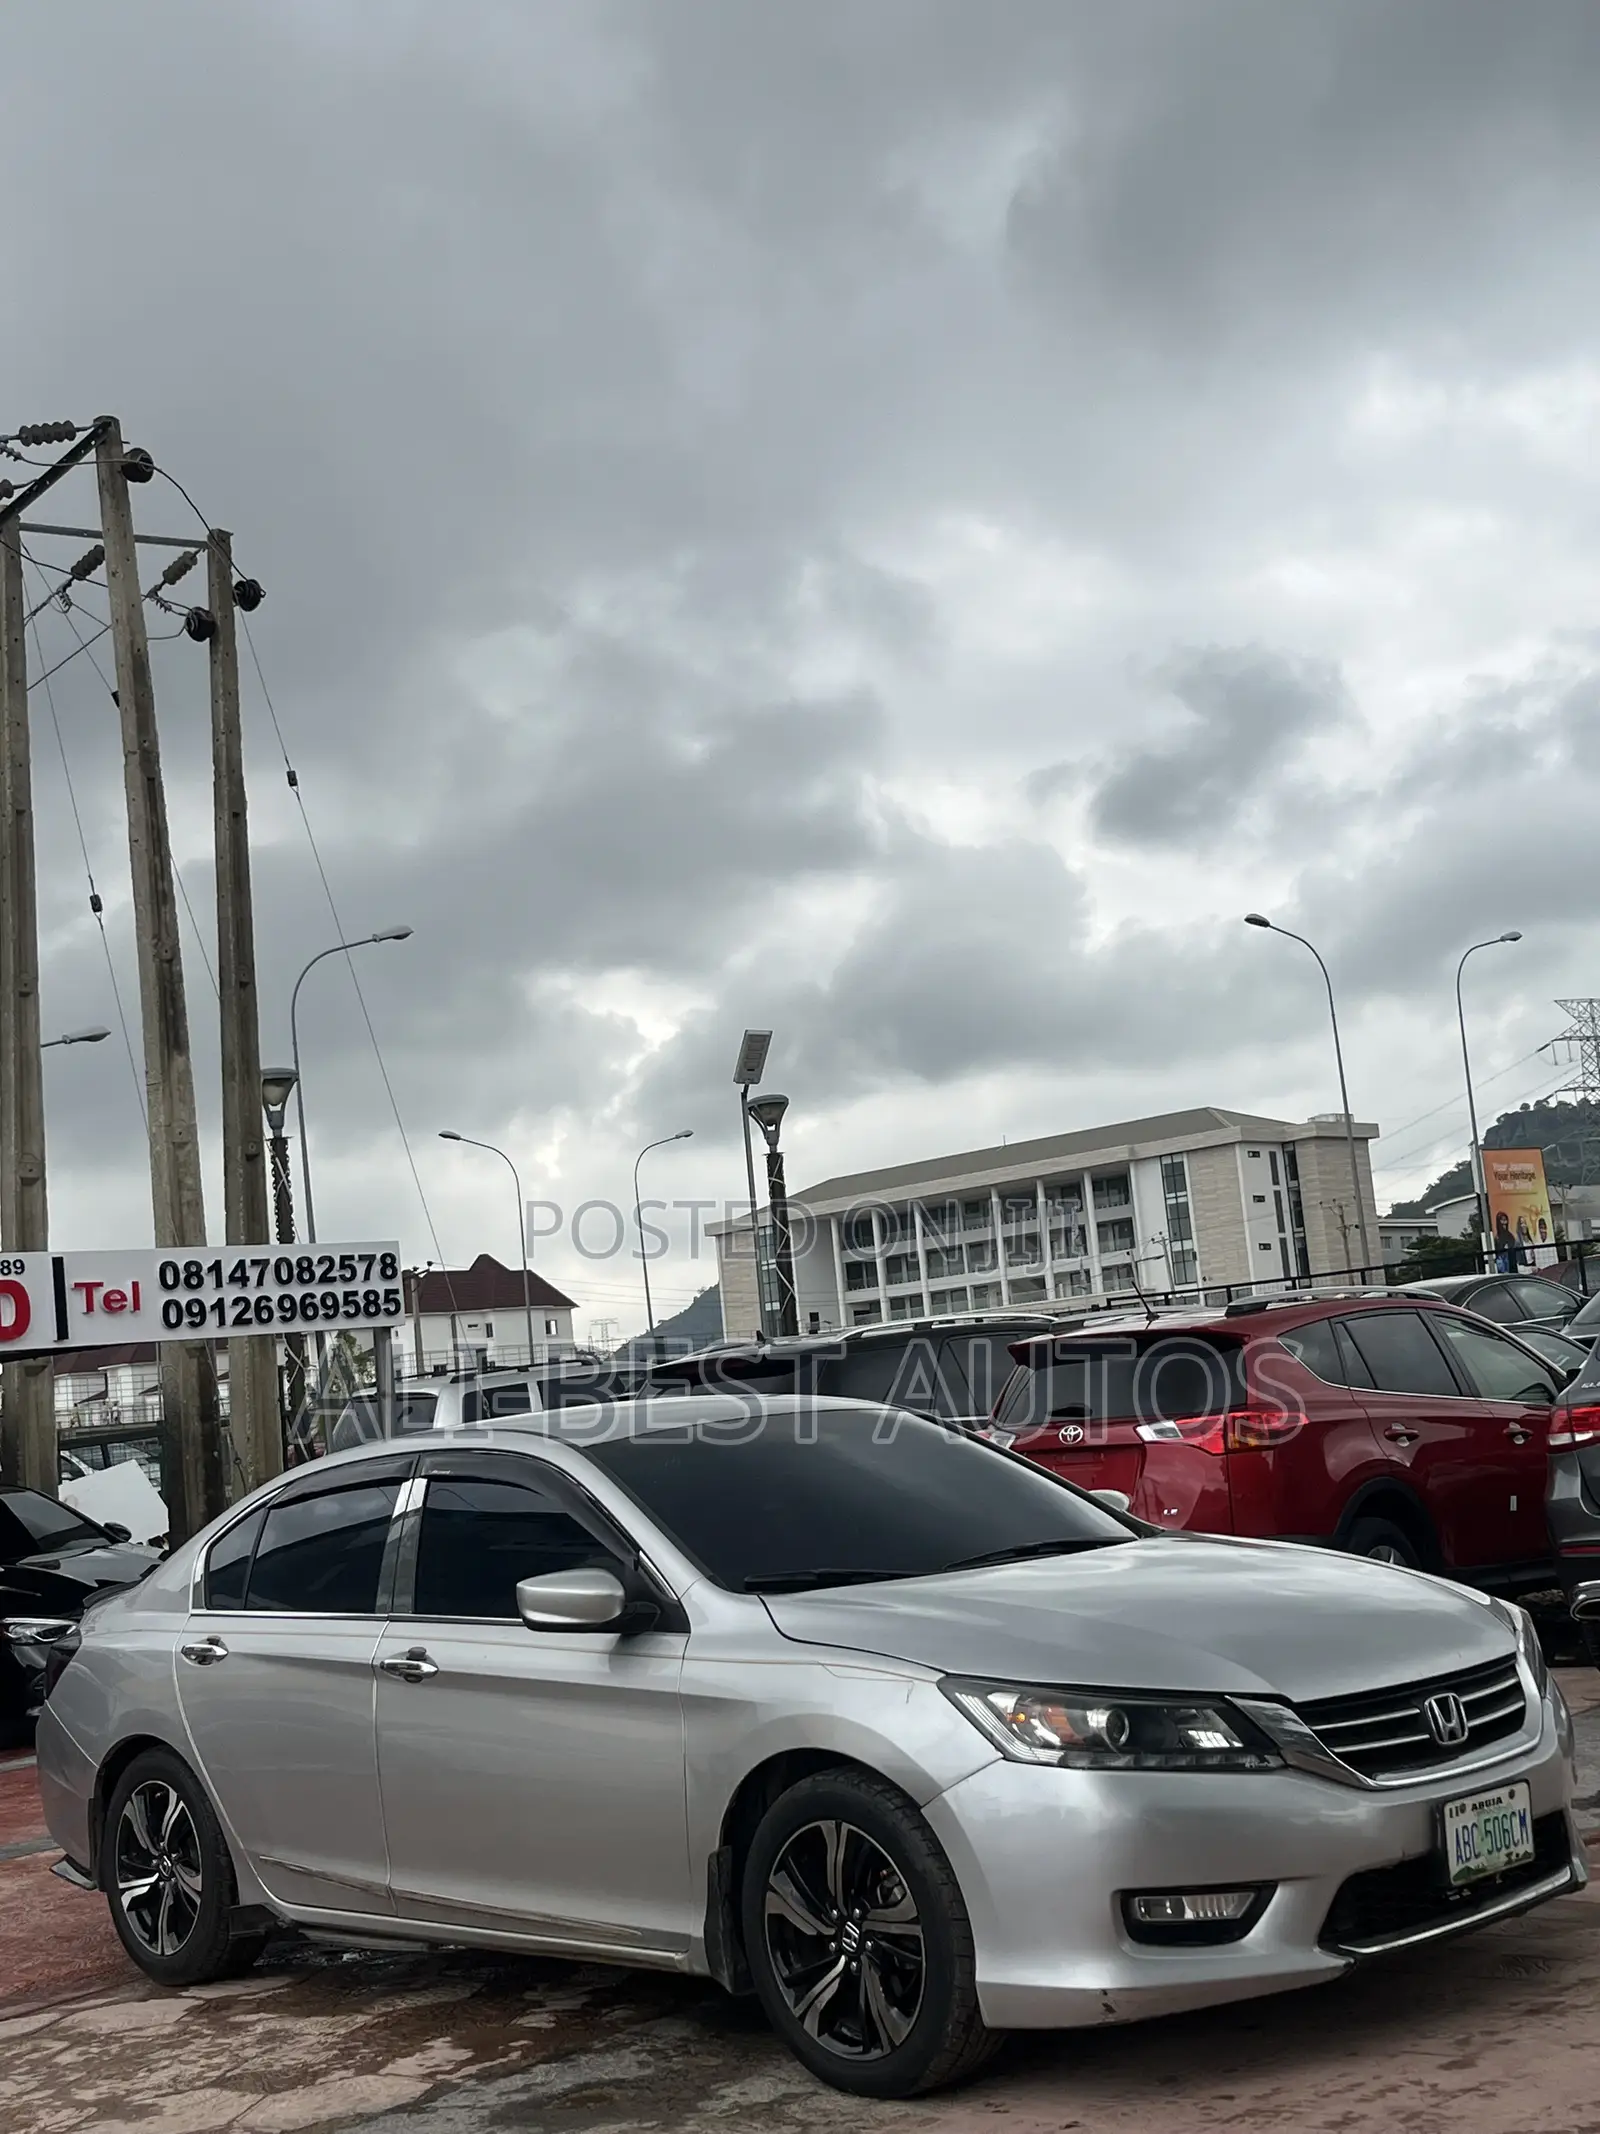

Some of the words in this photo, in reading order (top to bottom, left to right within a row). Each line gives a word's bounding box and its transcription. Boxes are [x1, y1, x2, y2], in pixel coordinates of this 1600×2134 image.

[159, 1252, 398, 1291] 08147082578
[73, 1281, 141, 1314] Tel
[162, 1288, 401, 1329] 09126969585
